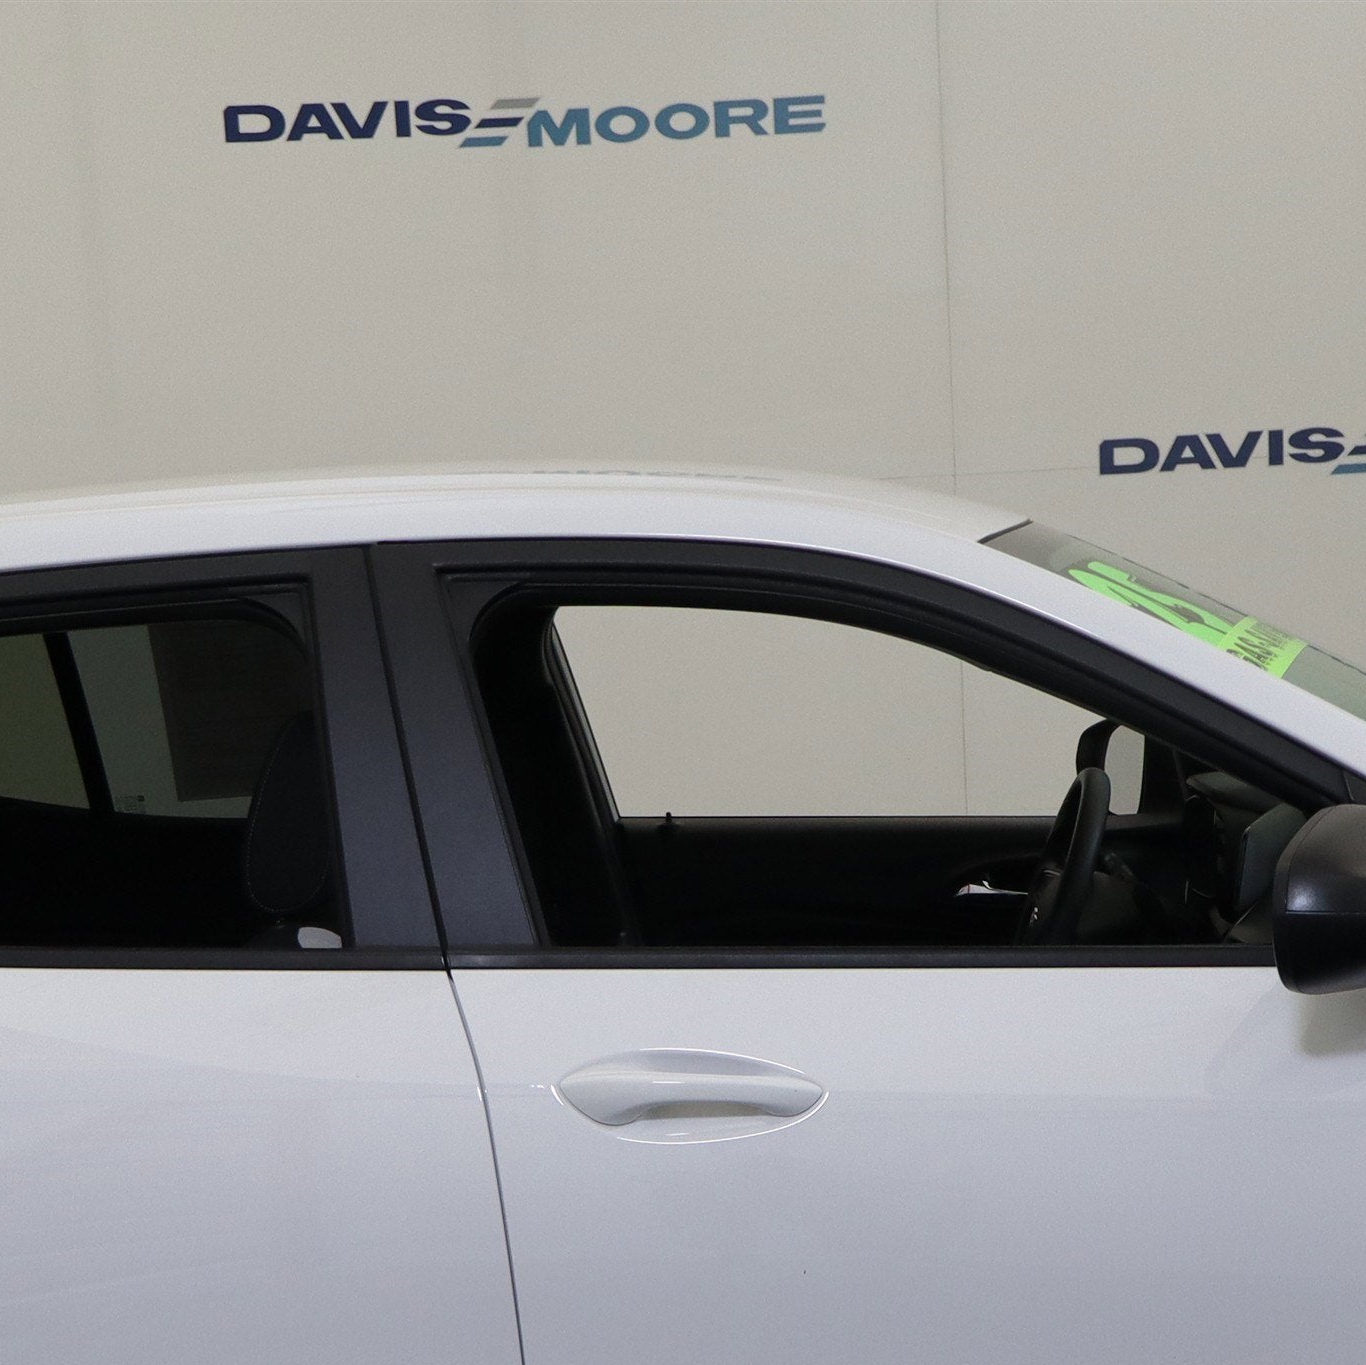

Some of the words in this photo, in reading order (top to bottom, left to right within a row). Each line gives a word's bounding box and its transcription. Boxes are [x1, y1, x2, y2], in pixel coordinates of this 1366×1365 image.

[223, 98, 473, 143] DAVIS
[527, 95, 827, 147] MOORE
[1099, 427, 1345, 475] DAVIS
